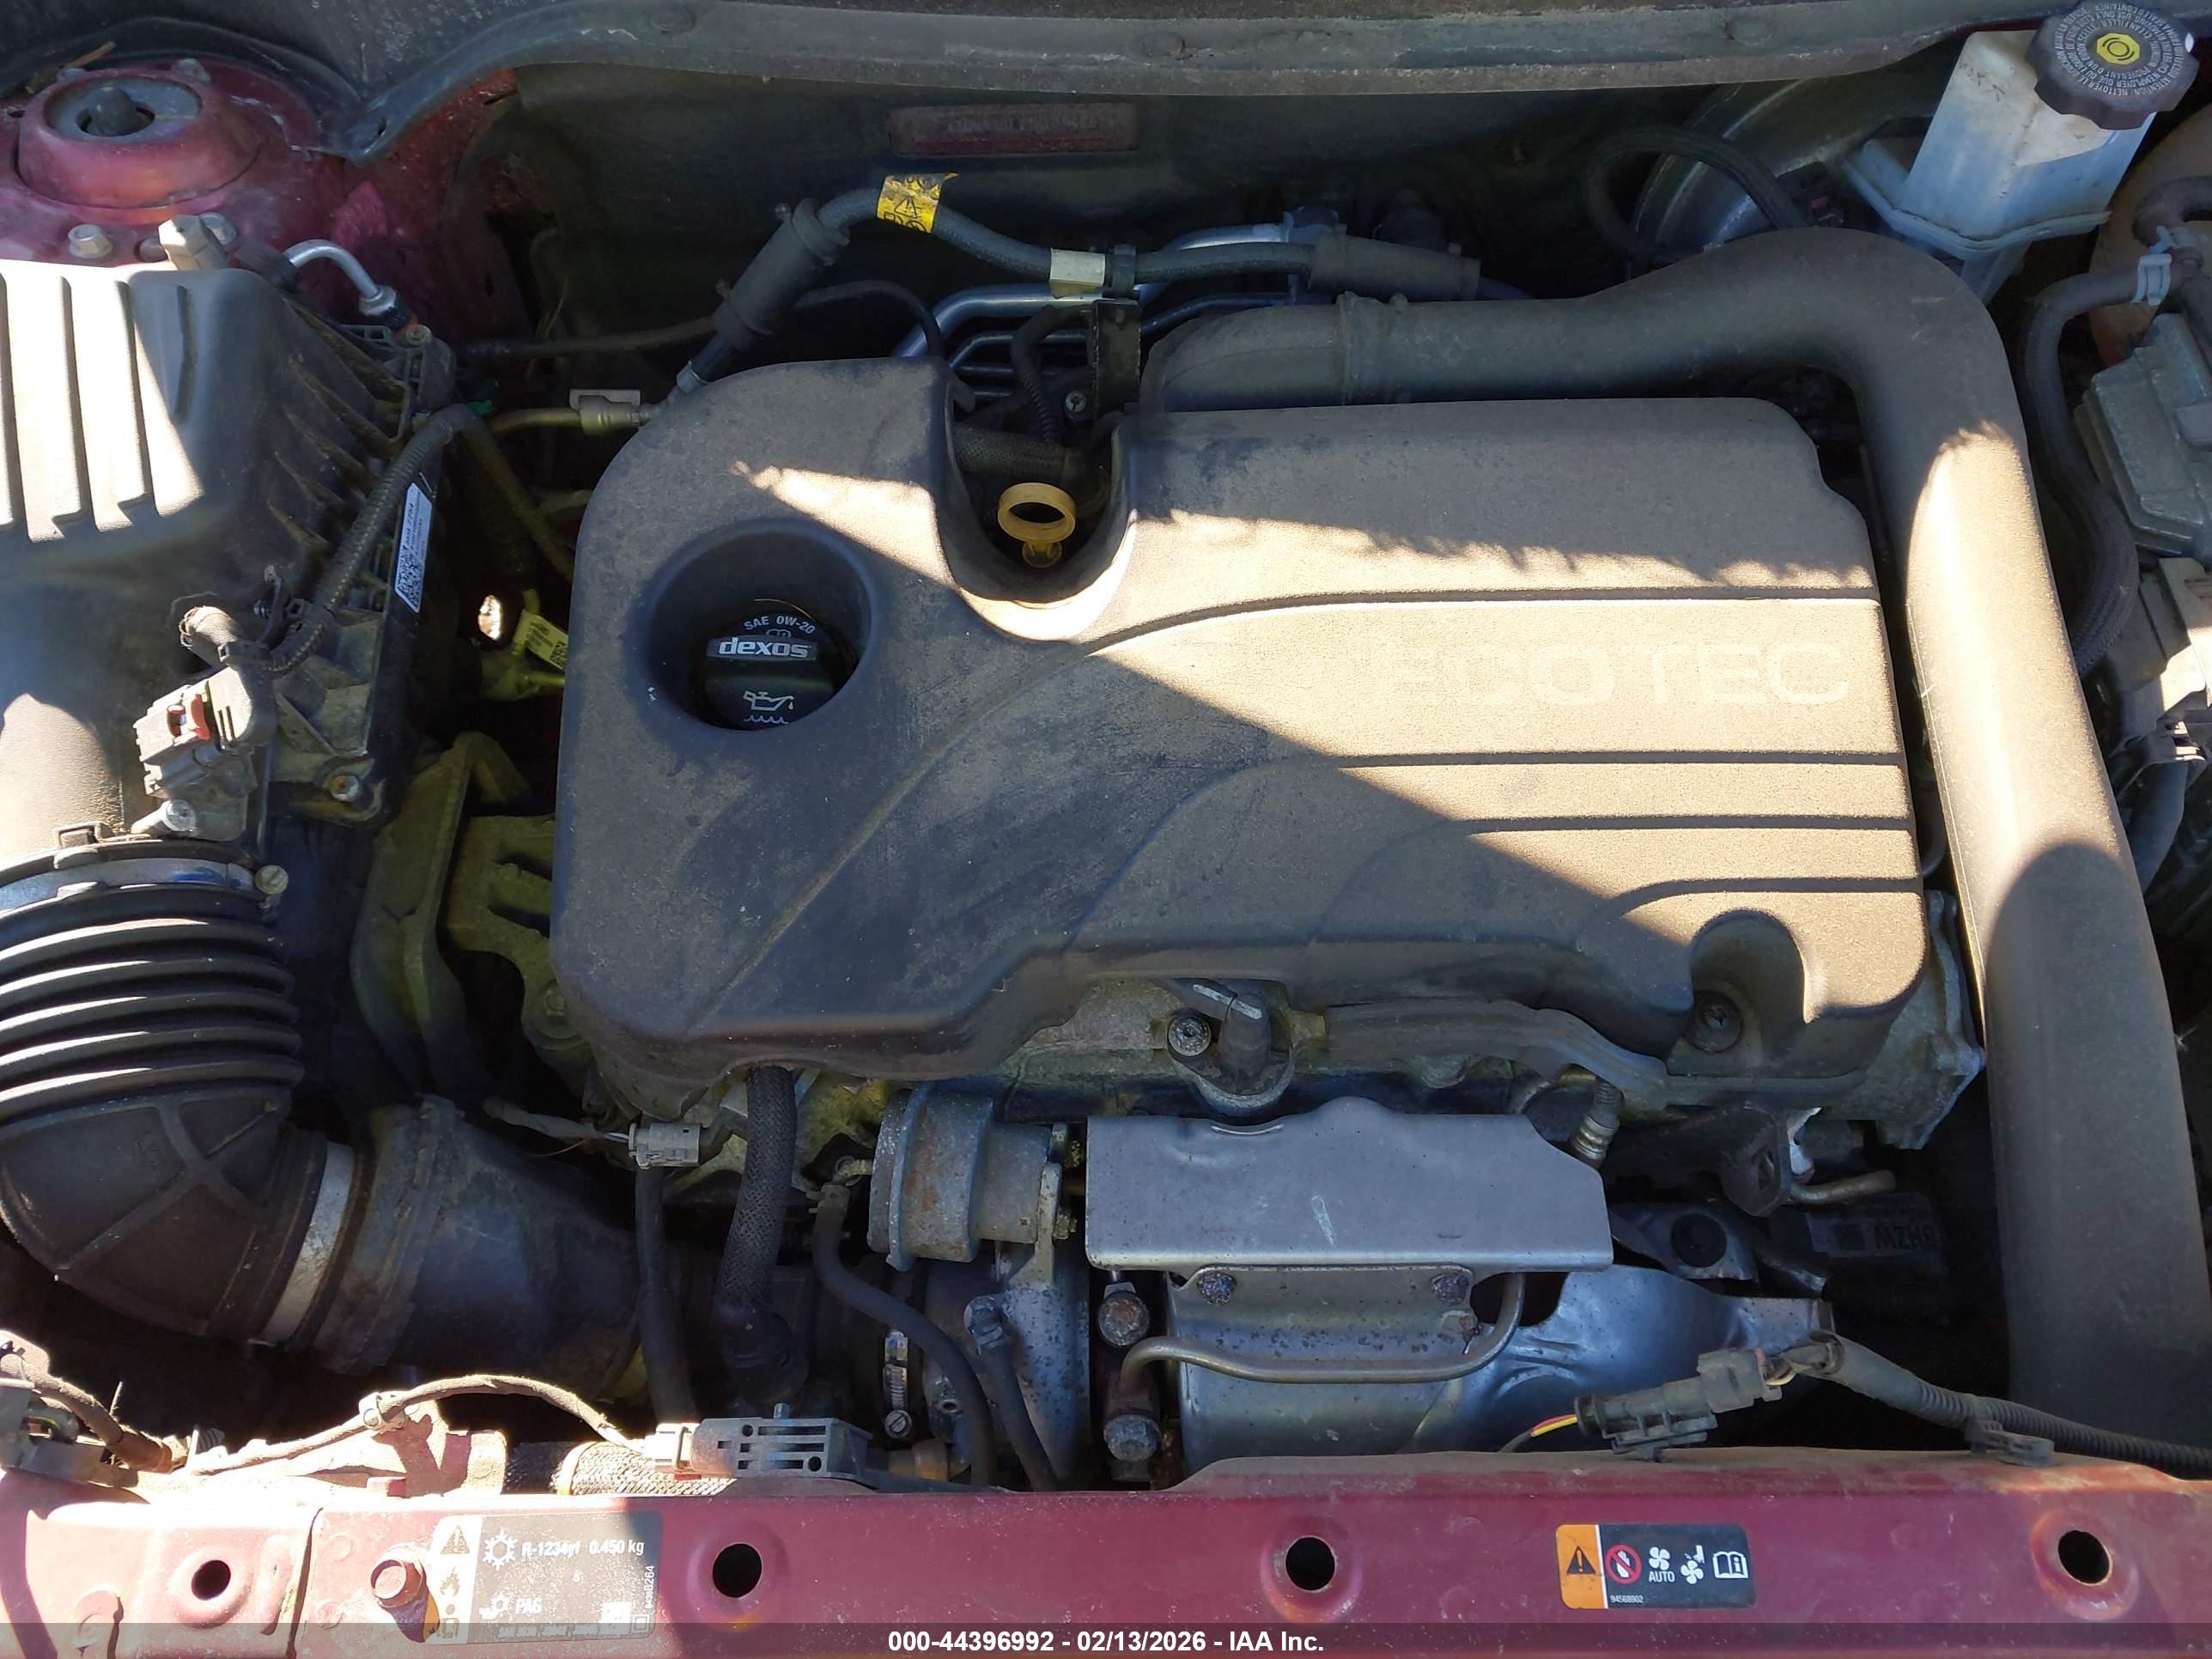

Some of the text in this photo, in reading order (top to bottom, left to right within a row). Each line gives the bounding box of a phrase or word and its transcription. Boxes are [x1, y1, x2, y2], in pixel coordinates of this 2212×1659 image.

[2102, 19, 2130, 27] FILLER
[2130, 22, 2152, 38] CLEAN
[2079, 76, 2088, 84] LE
[2098, 76, 2113, 86] QUE
[2088, 81, 2128, 96] NETTOYER
[744, 616, 770, 630] SAE
[776, 615, 816, 635] 0W-20
[719, 637, 809, 658] dexos
[588, 1539, 625, 1555] 0.450
[627, 1539, 644, 1556] kg
[1649, 1570, 1676, 1583] AUTO
